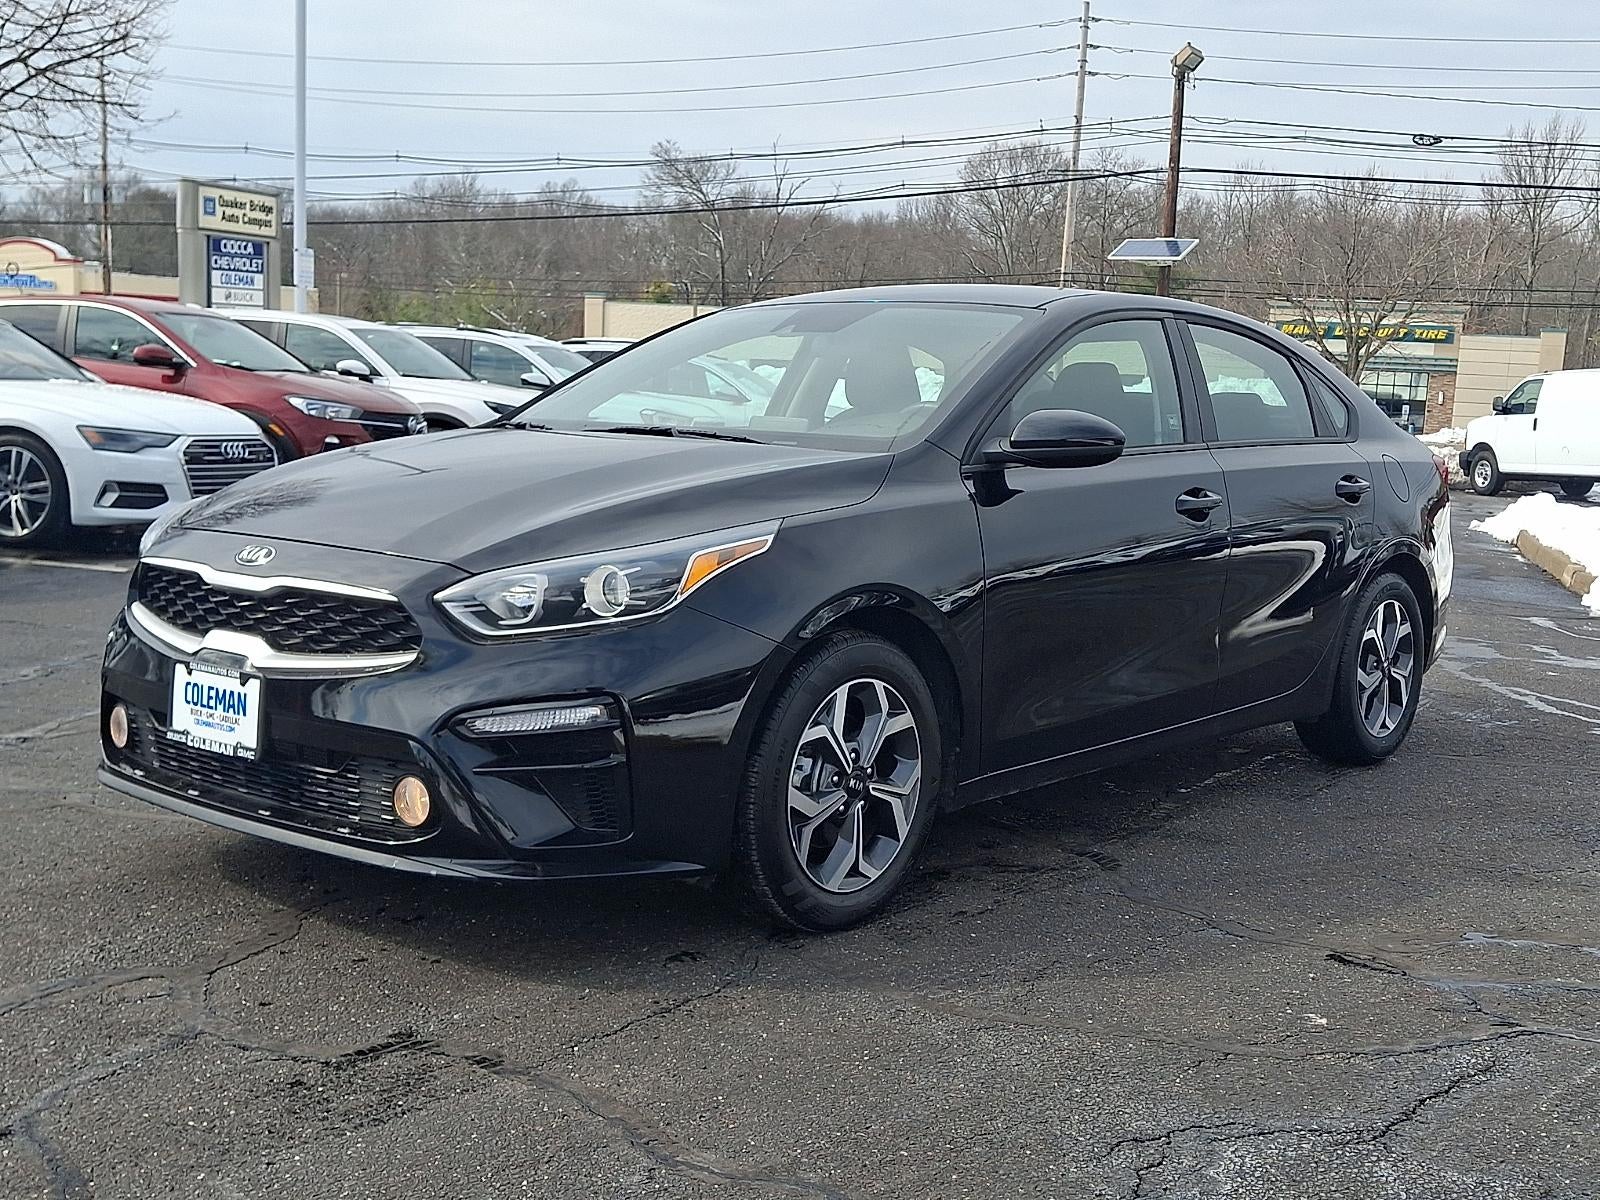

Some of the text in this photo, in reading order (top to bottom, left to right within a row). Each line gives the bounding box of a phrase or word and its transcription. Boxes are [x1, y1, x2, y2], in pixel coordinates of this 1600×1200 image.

[218, 195, 247, 210] Quaker
[250, 200, 273, 216] Bridge
[221, 211, 272, 230] Auto Campus
[220, 239, 255, 255] CIOCCA
[211, 255, 263, 272] CHEVROLET
[220, 272, 255, 287] COLEMAN
[233, 291, 254, 302] BUICK
[1415, 328, 1449, 339] TIRE
[237, 545, 273, 563] KIA
[184, 681, 247, 717] COLEMAN
[187, 735, 234, 757] COLEMAN
[237, 748, 256, 760] GMC
[848, 777, 864, 792] KIA
